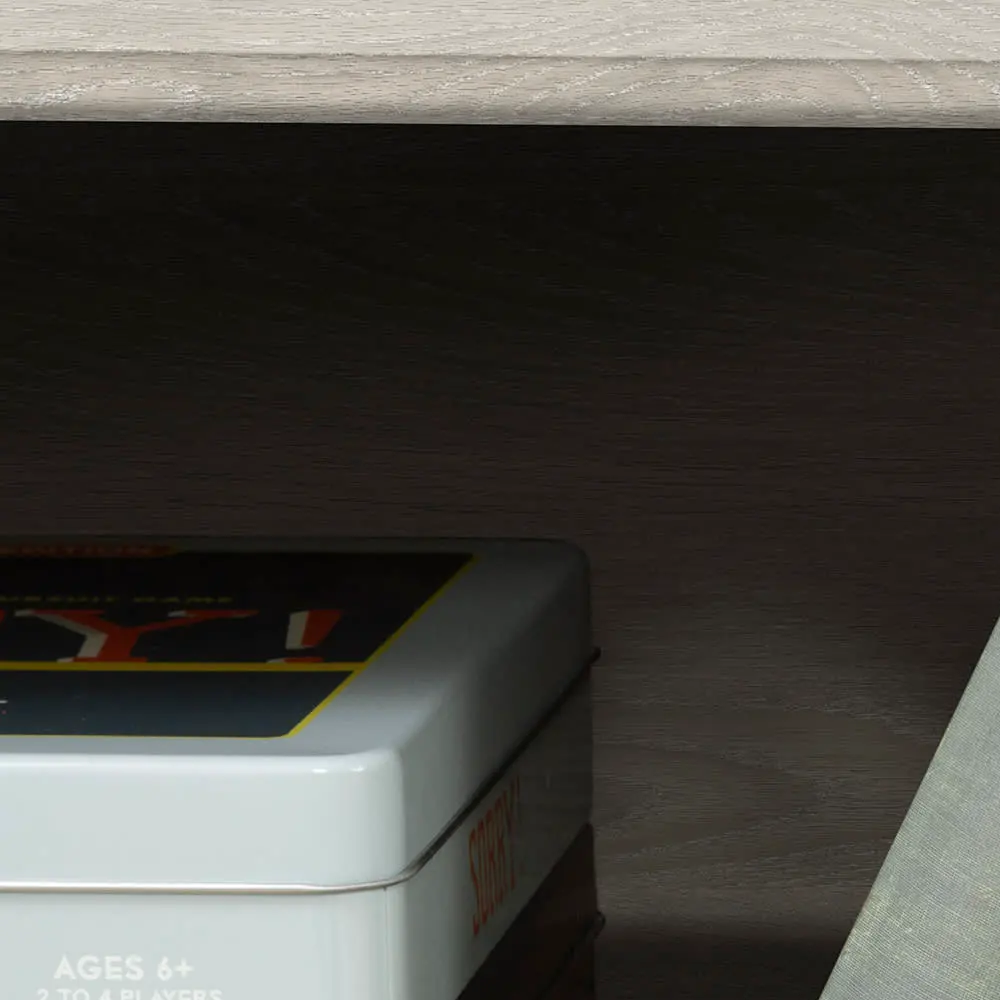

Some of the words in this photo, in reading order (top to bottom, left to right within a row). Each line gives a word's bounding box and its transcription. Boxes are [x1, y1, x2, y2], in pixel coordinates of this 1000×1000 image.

[0, 609, 345, 664] Y!
[53, 954, 145, 982] AGES
[156, 955, 195, 982] 6+
